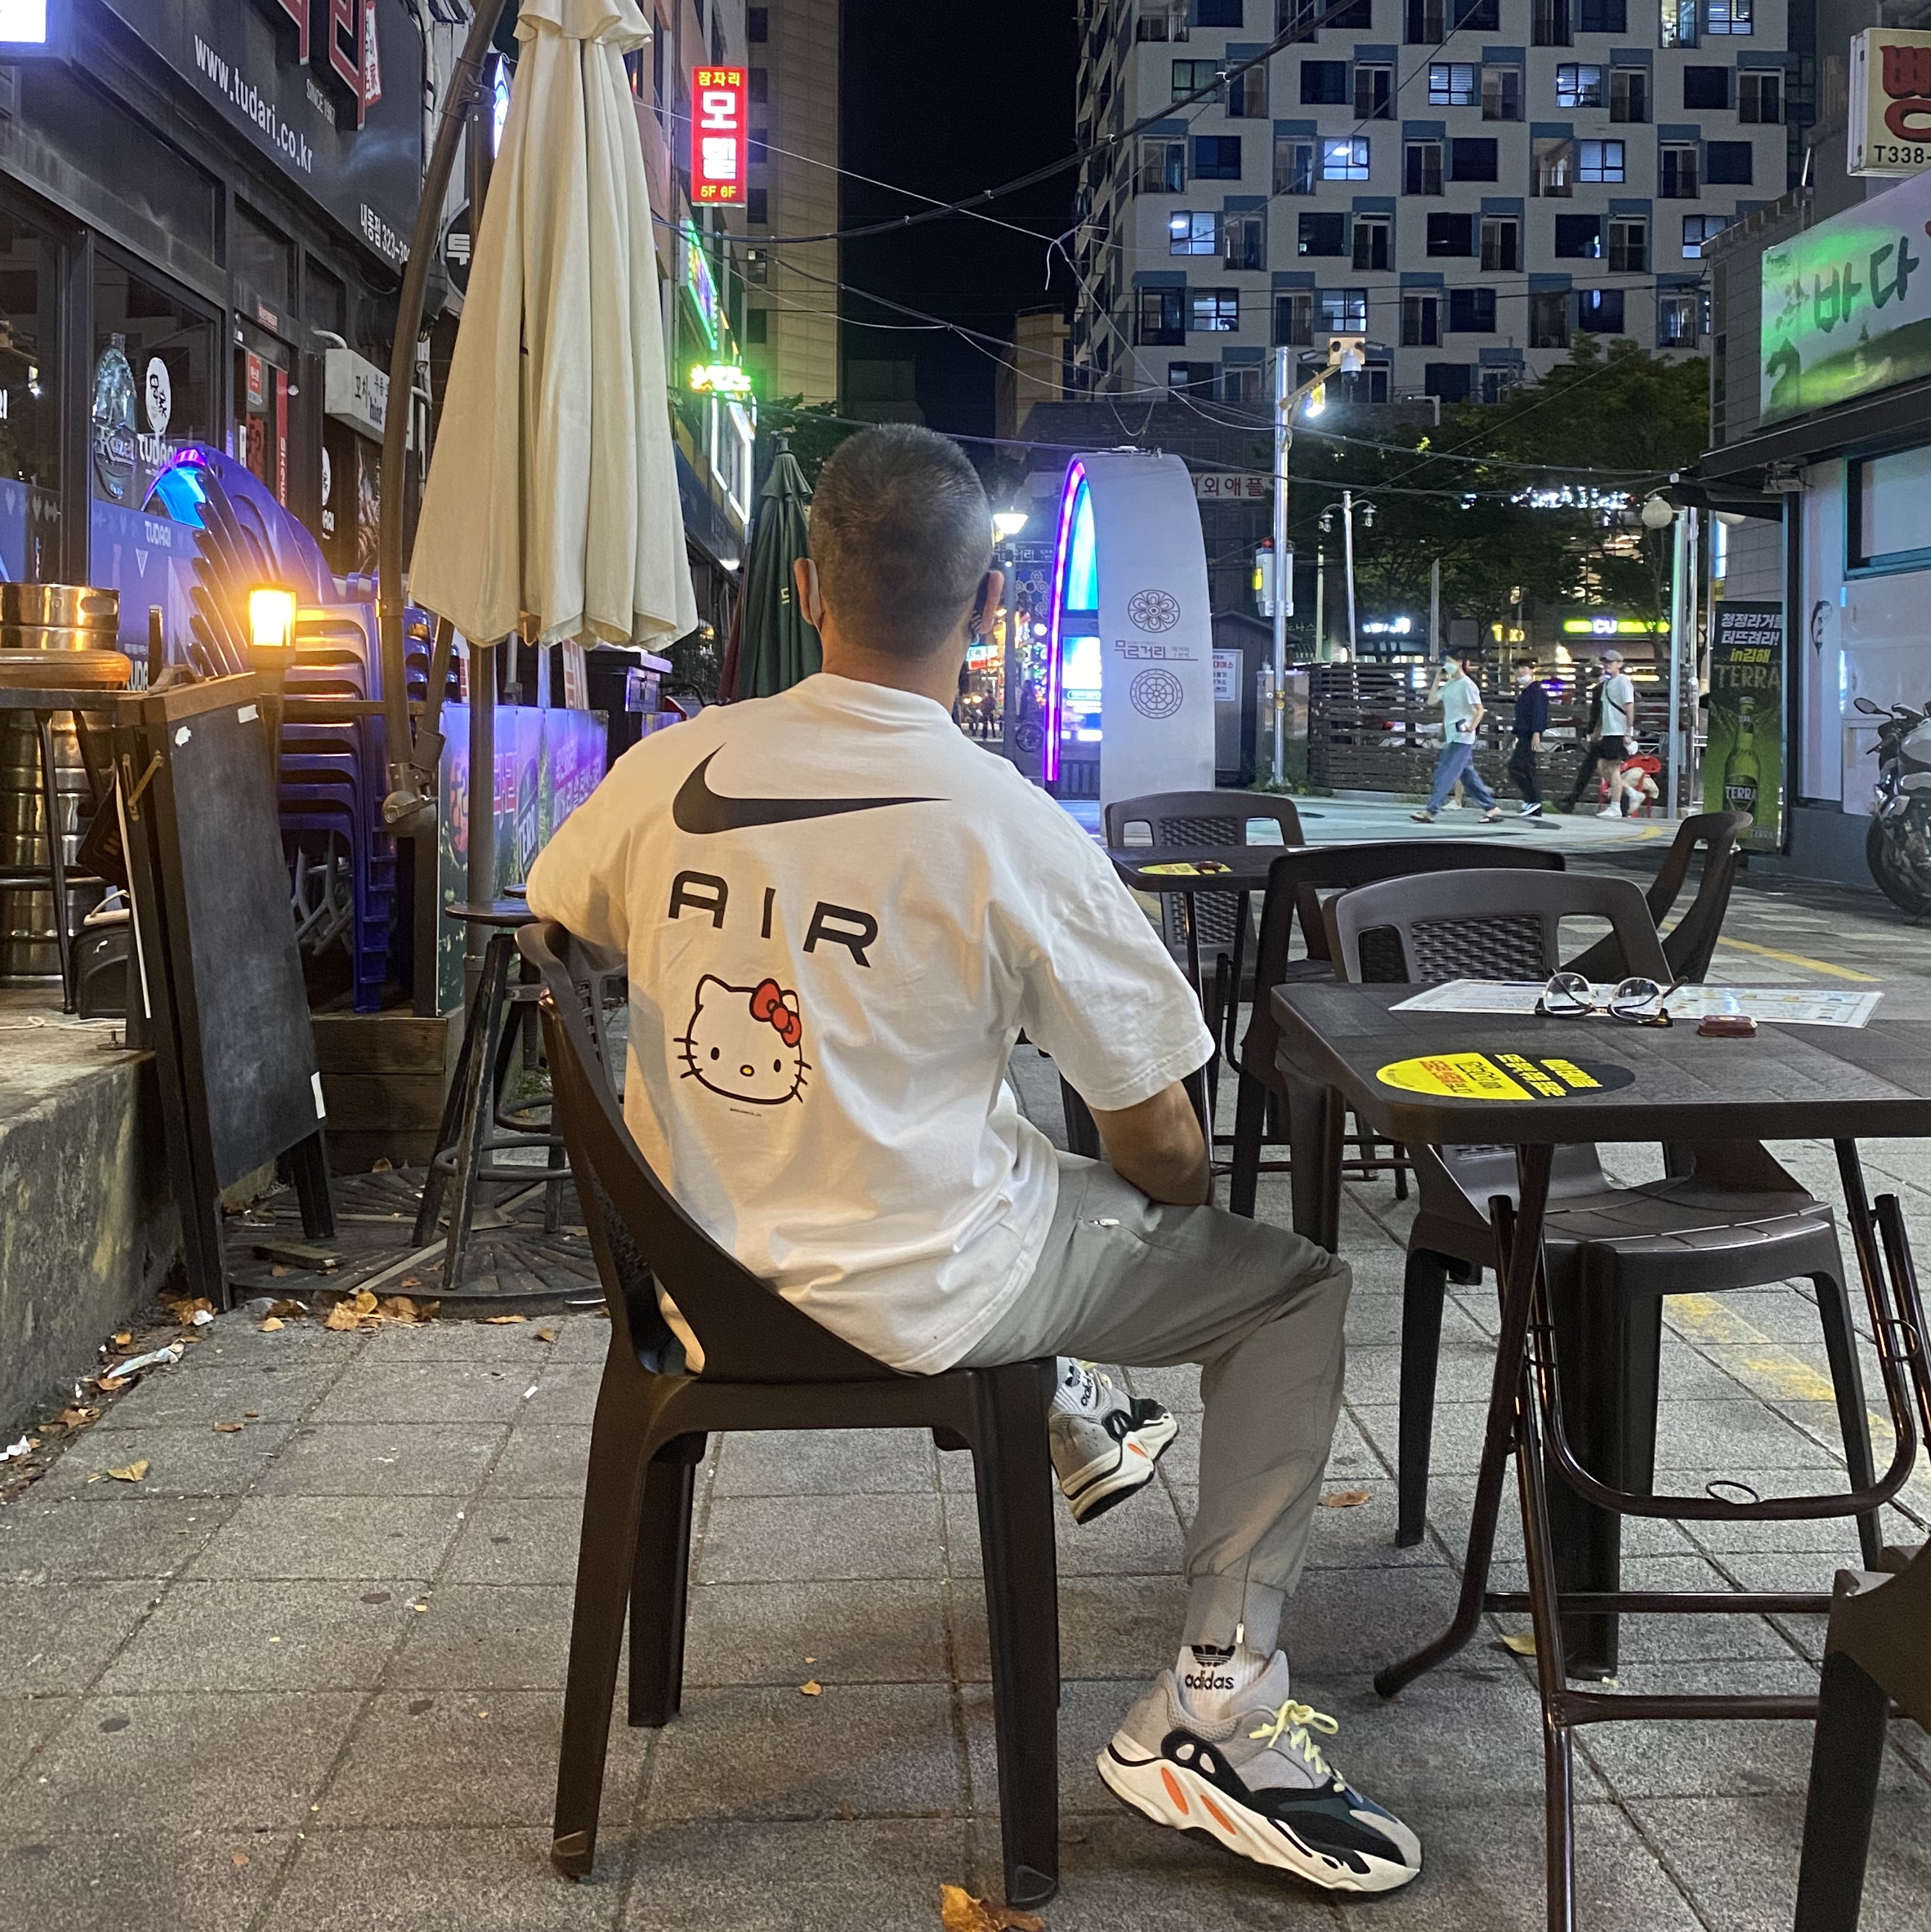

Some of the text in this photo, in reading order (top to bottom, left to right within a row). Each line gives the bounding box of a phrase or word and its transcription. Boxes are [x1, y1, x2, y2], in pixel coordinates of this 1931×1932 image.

[698, 71, 741, 86] 잠자리
[194, 34, 313, 174] www.tudari.co.kr
[700, 185, 737, 198] 5F 6F
[145, 521, 171, 547] TUDARI
[1594, 619, 1617, 634] CU
[1730, 648, 1771, 664] in김해
[1713, 664, 1782, 689] TERRA
[1725, 786, 1757, 801] TERRA
[668, 870, 879, 968] AIR
[1185, 1670, 1235, 1691] adidas
